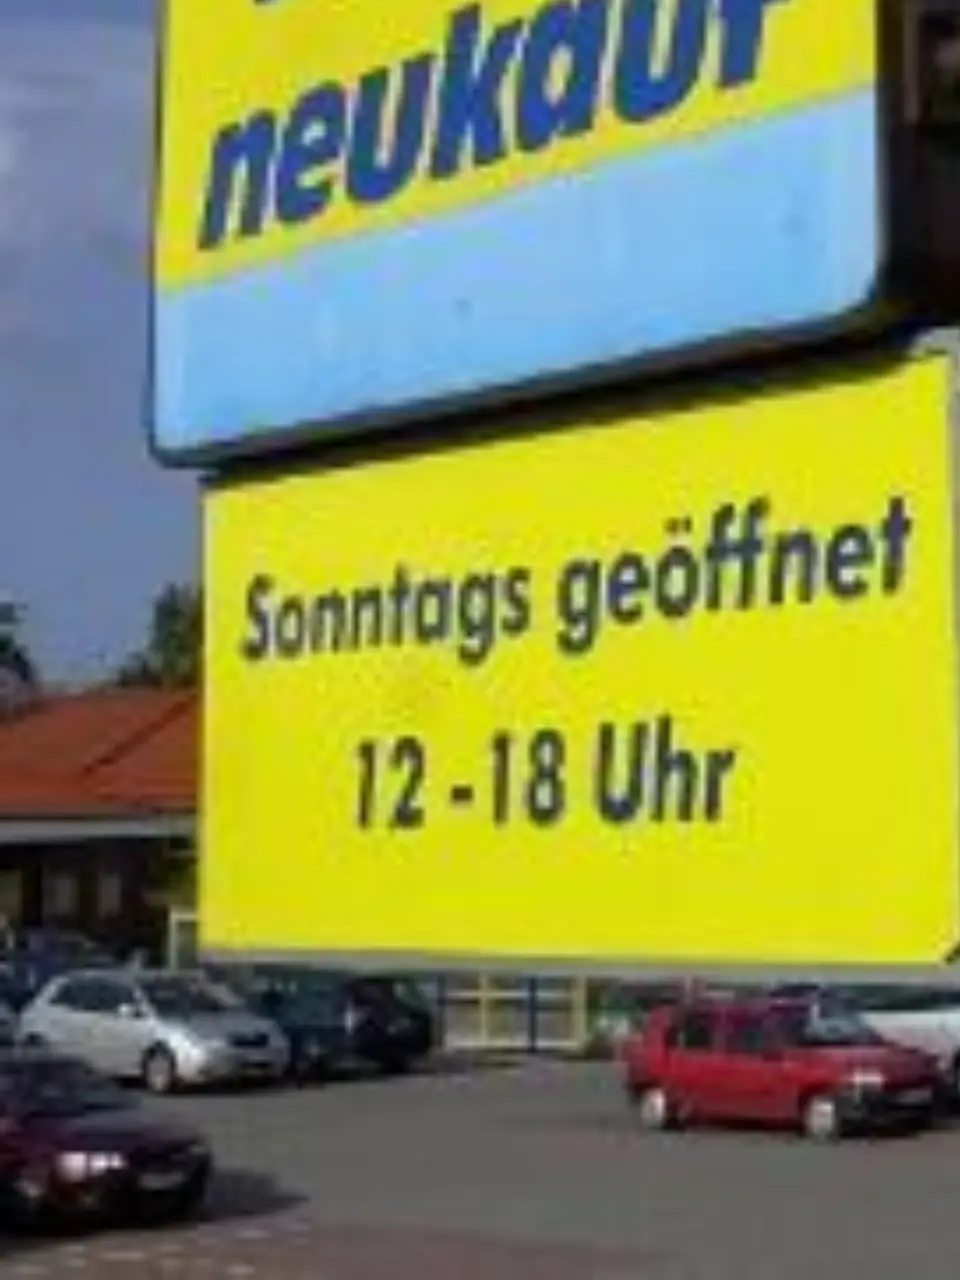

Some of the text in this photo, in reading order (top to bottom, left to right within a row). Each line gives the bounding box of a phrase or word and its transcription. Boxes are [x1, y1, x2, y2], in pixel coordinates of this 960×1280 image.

[241, 496, 914, 667] Sonntags geöffnet
[594, 713, 737, 826] Uhr
